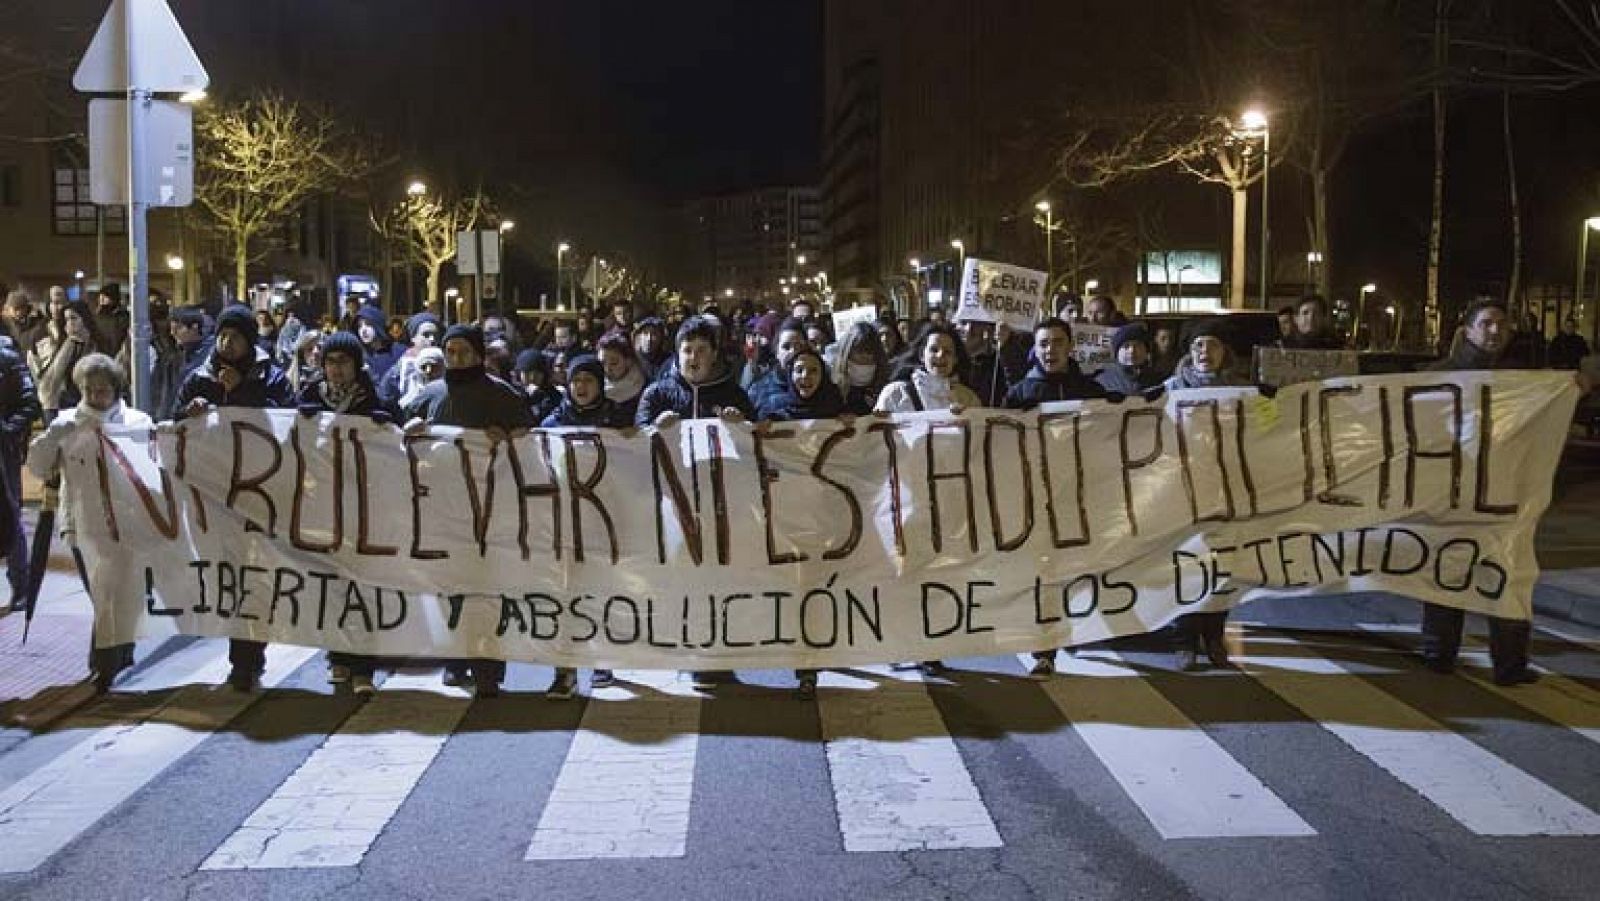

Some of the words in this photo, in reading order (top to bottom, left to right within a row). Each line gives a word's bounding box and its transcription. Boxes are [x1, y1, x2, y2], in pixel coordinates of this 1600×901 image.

[970, 268, 1039, 295] BLEVAR
[226, 420, 620, 566] BULEVAR
[651, 424, 731, 565] NI
[752, 413, 1091, 565] ESTADO
[1119, 384, 1517, 536] POLICIAL
[145, 560, 408, 632] LIBERTAD
[496, 573, 884, 649] ABSOLUCIÓN
[922, 581, 997, 639] DE
[1035, 572, 1138, 625] LOS
[1172, 527, 1507, 606] DETENIDOS
